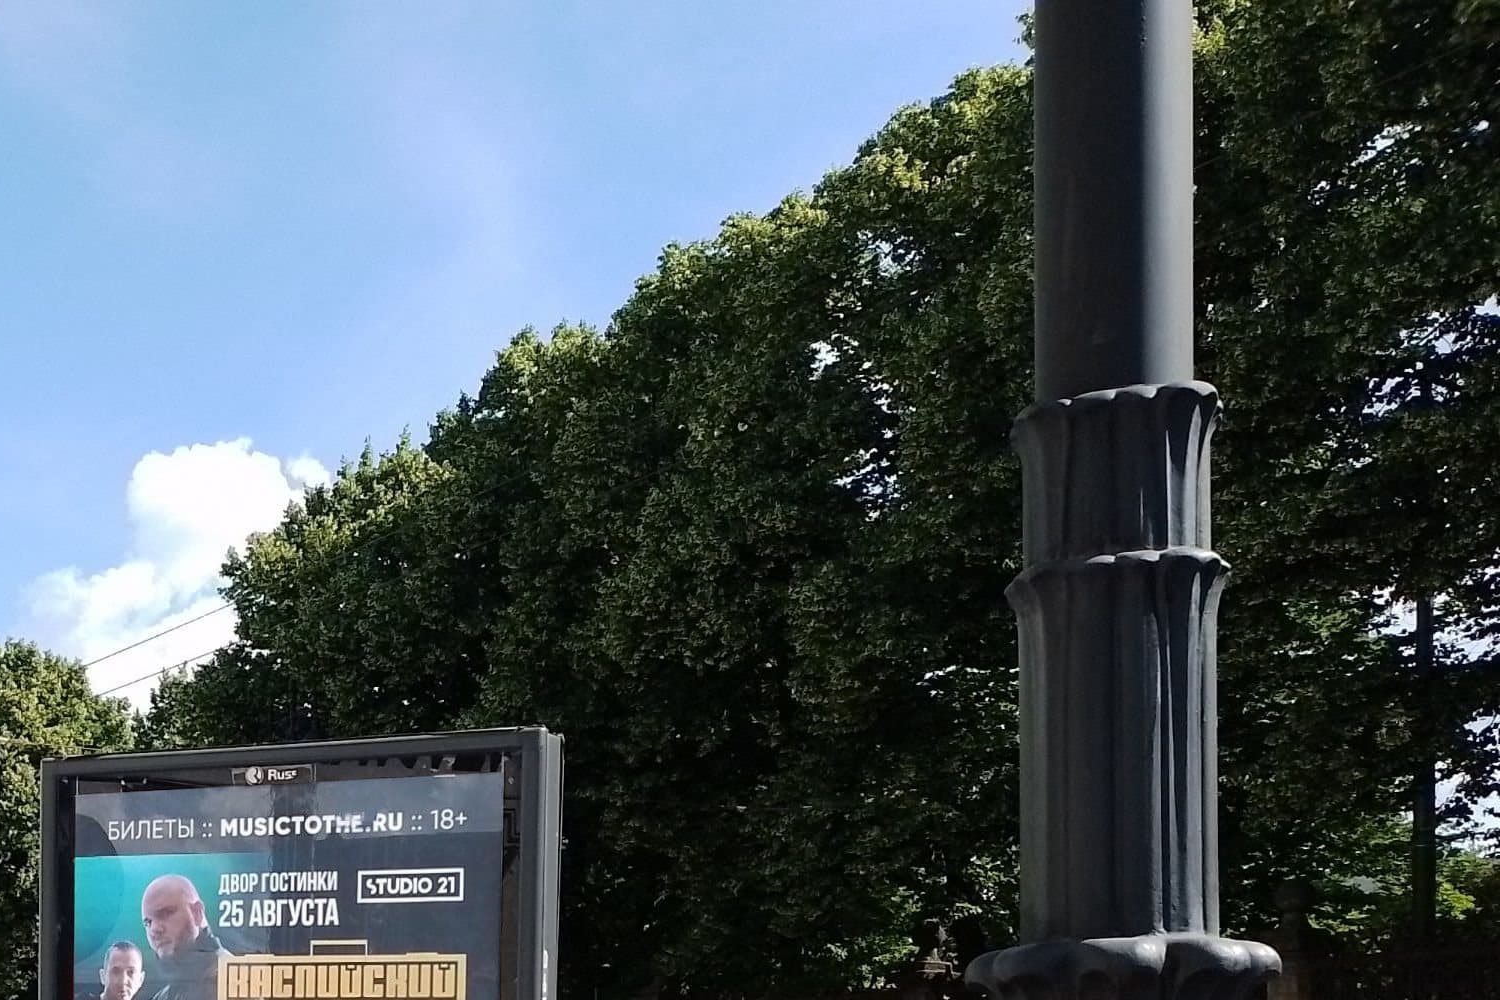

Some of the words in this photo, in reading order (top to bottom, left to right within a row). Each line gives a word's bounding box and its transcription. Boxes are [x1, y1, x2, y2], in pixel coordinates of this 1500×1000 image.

[108, 819, 194, 840] БИЛЕТЫ
[220, 812, 403, 838] MUSICTOTHE.RU
[430, 809, 468, 831] 18+
[218, 872, 258, 895] ДВОР
[261, 871, 338, 893] ГОСТИНКИ
[366, 877, 433, 896] STUDIO
[437, 877, 456, 894] 21
[218, 899, 244, 927] 25
[250, 898, 340, 927] АВГУСТА
[227, 963, 457, 999] КАСПИЙСКИЙ
